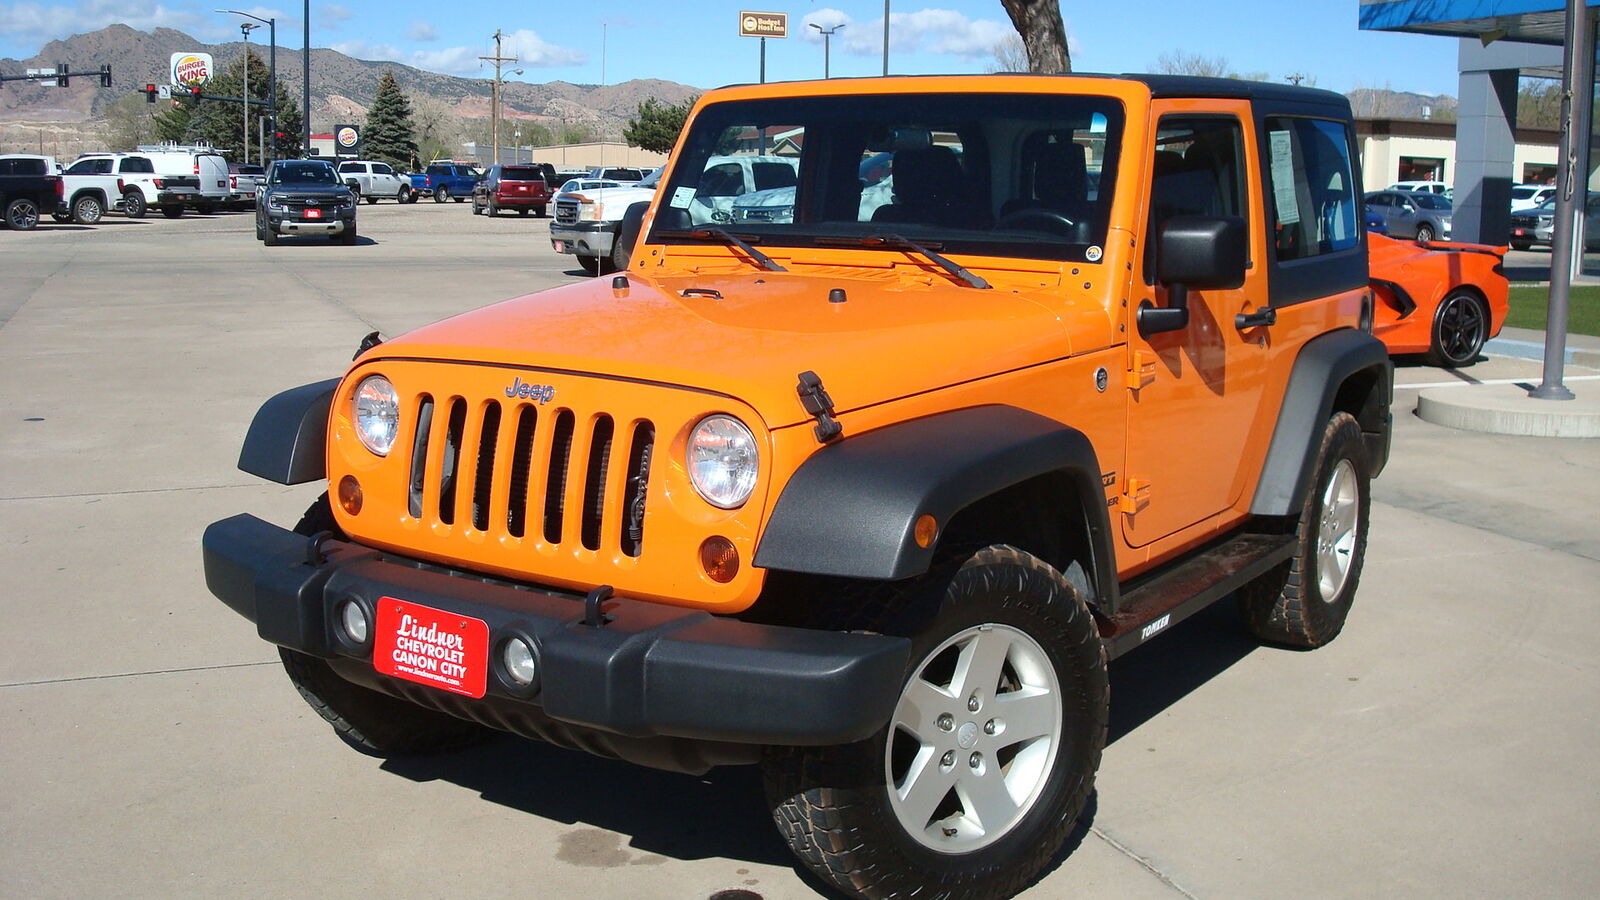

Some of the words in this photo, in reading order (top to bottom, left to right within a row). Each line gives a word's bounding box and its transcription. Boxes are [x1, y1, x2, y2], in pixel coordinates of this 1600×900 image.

[177, 60, 206, 73] BURGER
[179, 68, 207, 83] KING
[505, 376, 555, 405] Jeep
[396, 614, 464, 651] Lindner
[392, 649, 438, 671] CANON
[440, 662, 467, 679] CITY
[396, 637, 465, 664] CHEVROLET
